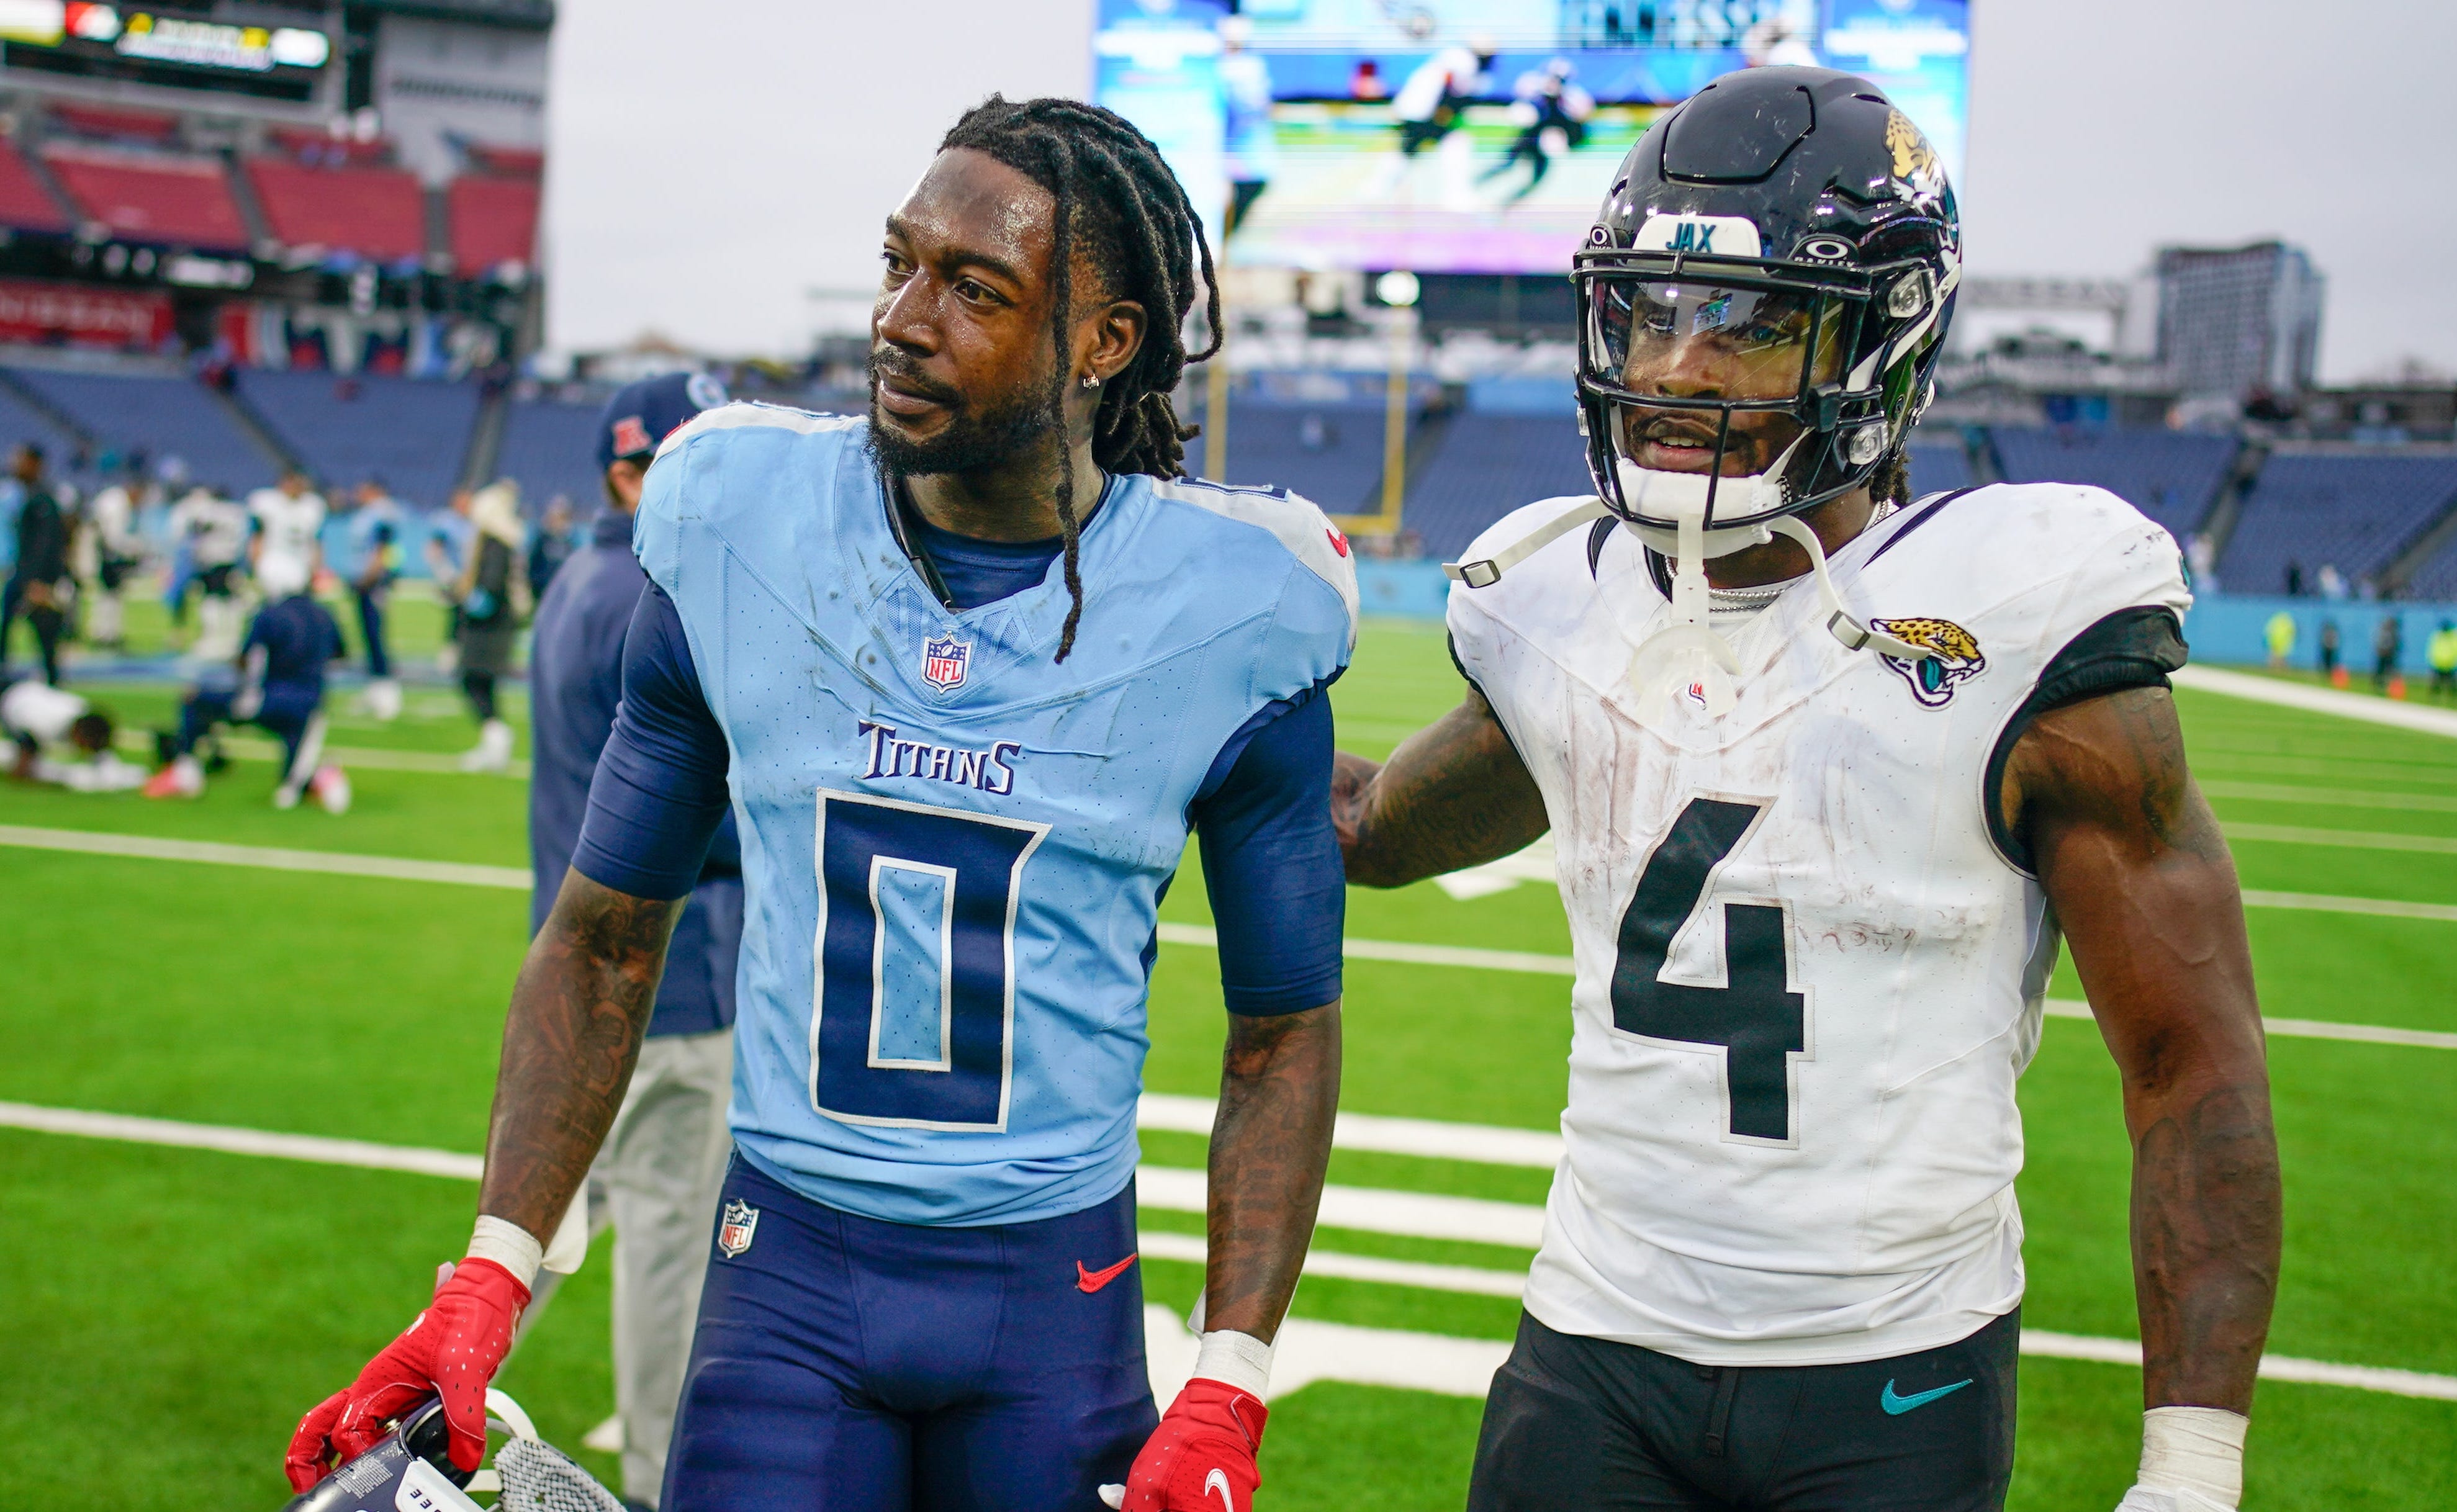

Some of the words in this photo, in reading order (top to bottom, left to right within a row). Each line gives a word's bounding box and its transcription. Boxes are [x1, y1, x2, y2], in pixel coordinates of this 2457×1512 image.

[1666, 222, 1716, 253] JAX
[928, 658, 961, 683] NFL
[808, 788, 1053, 1133] 0
[1609, 788, 1814, 1148] 4
[723, 1225, 746, 1248] NFL
